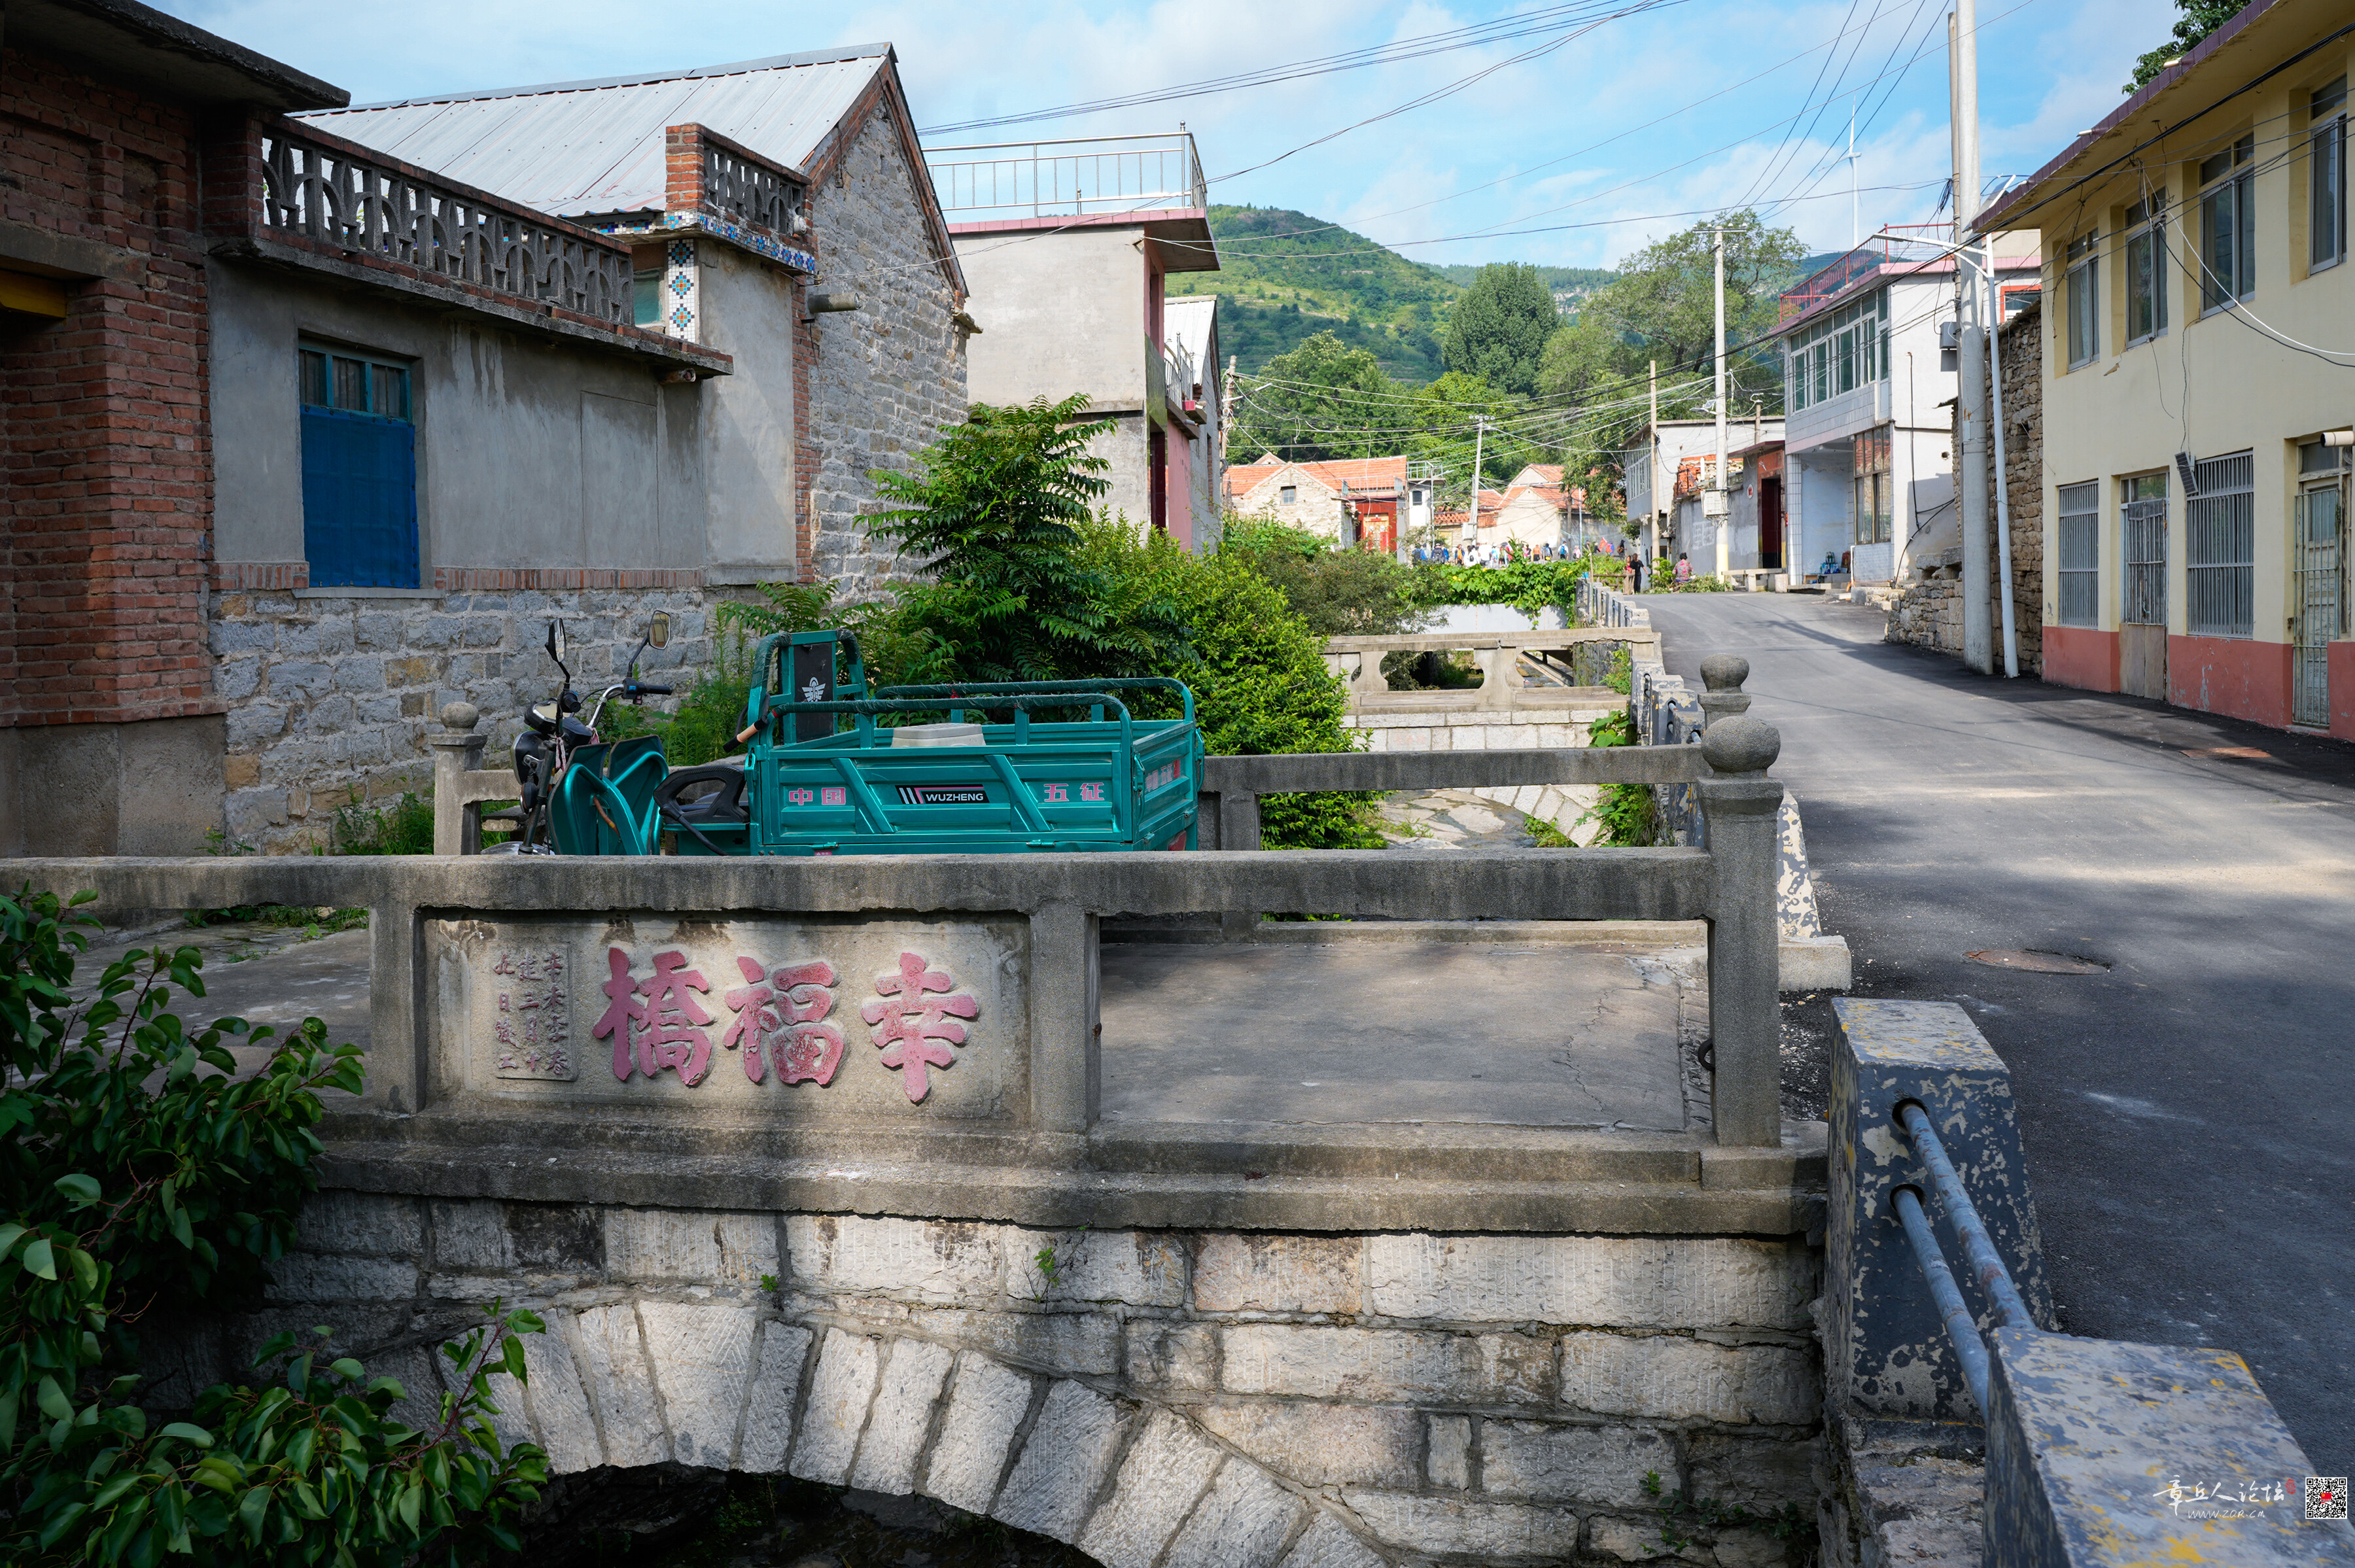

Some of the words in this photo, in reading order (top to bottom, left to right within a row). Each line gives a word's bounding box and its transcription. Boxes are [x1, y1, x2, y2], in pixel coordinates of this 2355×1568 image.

[789, 787, 846, 805] 中国
[926, 793, 984, 801] WUZHENG
[1043, 782, 1105, 801] 五征
